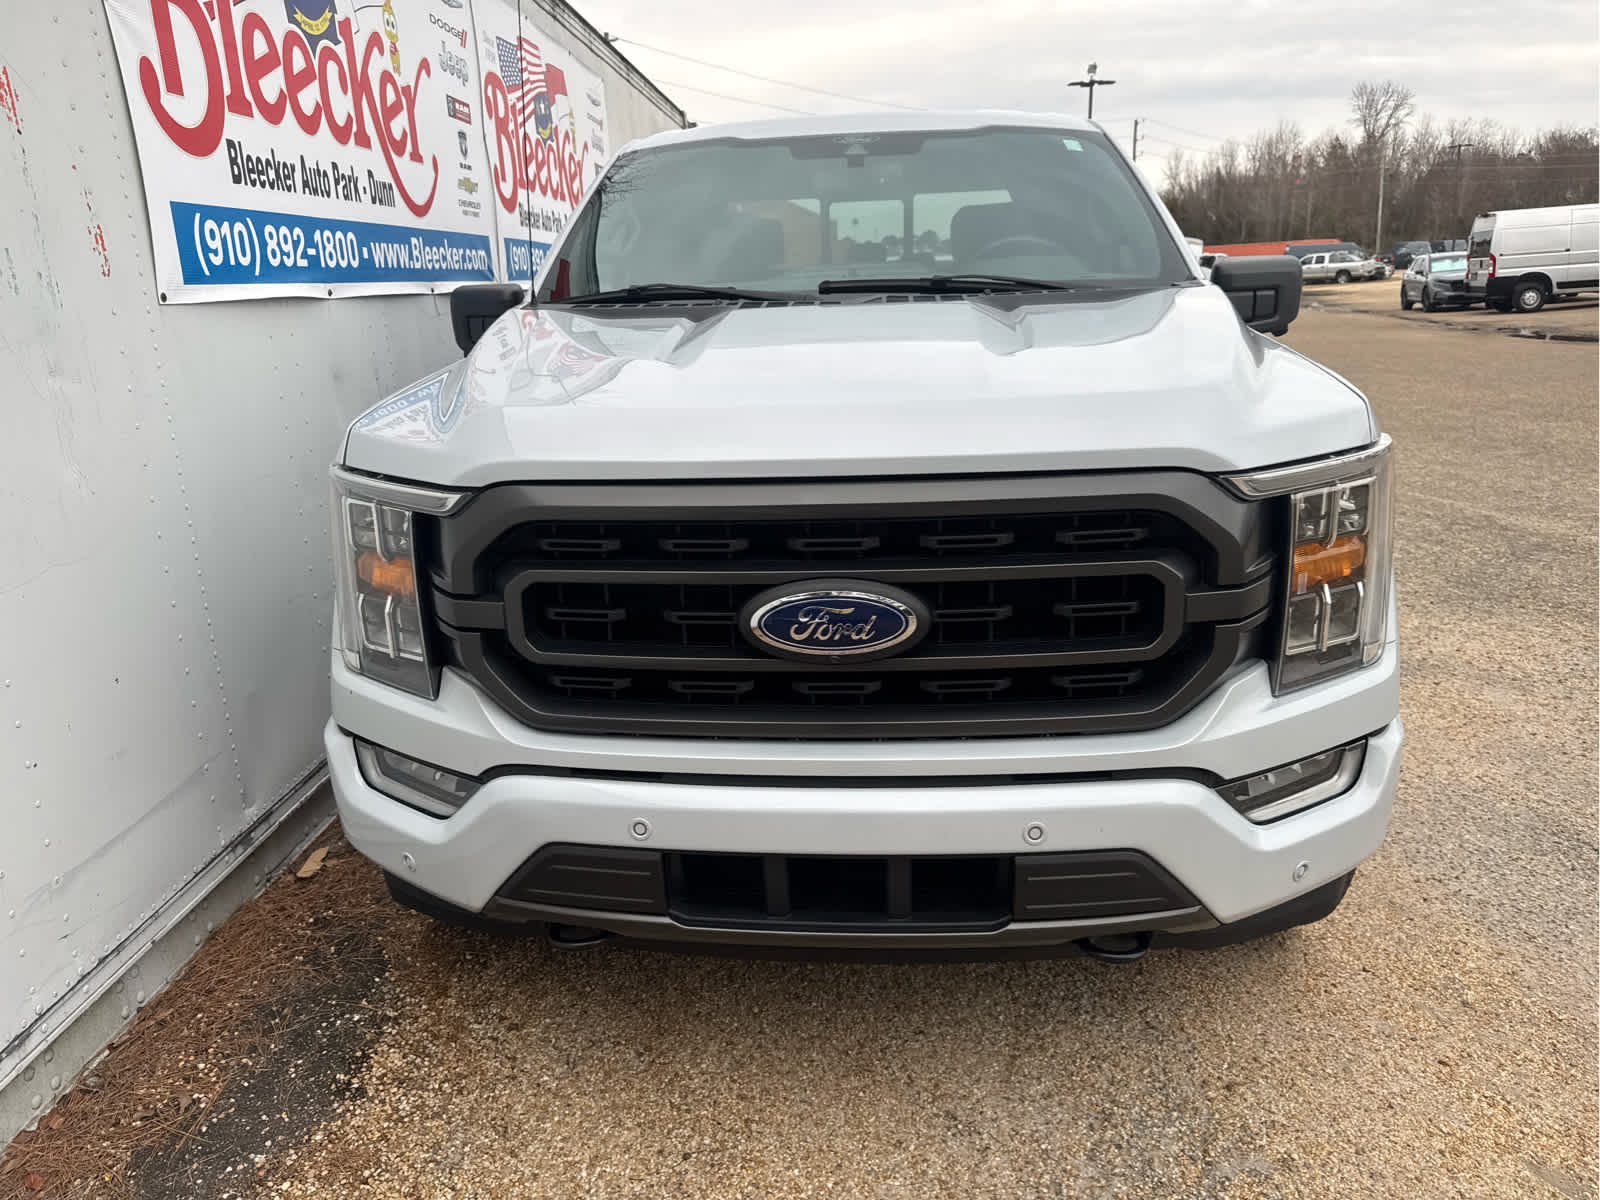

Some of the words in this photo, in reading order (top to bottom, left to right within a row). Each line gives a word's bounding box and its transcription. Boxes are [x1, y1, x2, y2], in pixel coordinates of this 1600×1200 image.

[429, 13, 464, 40] DODGE
[438, 39, 469, 87] Jeep
[483, 71, 589, 214] Bleecker
[225, 138, 297, 193] Bleecker
[299, 154, 331, 199] Auto
[331, 161, 362, 203] Park
[367, 169, 396, 208] Dunn
[194, 212, 260, 276] (910)
[264, 224, 359, 269] 892-1800
[370, 236, 488, 271] www.Bleecker.com
[510, 242, 531, 277] (910)
[790, 605, 877, 641] Ford
